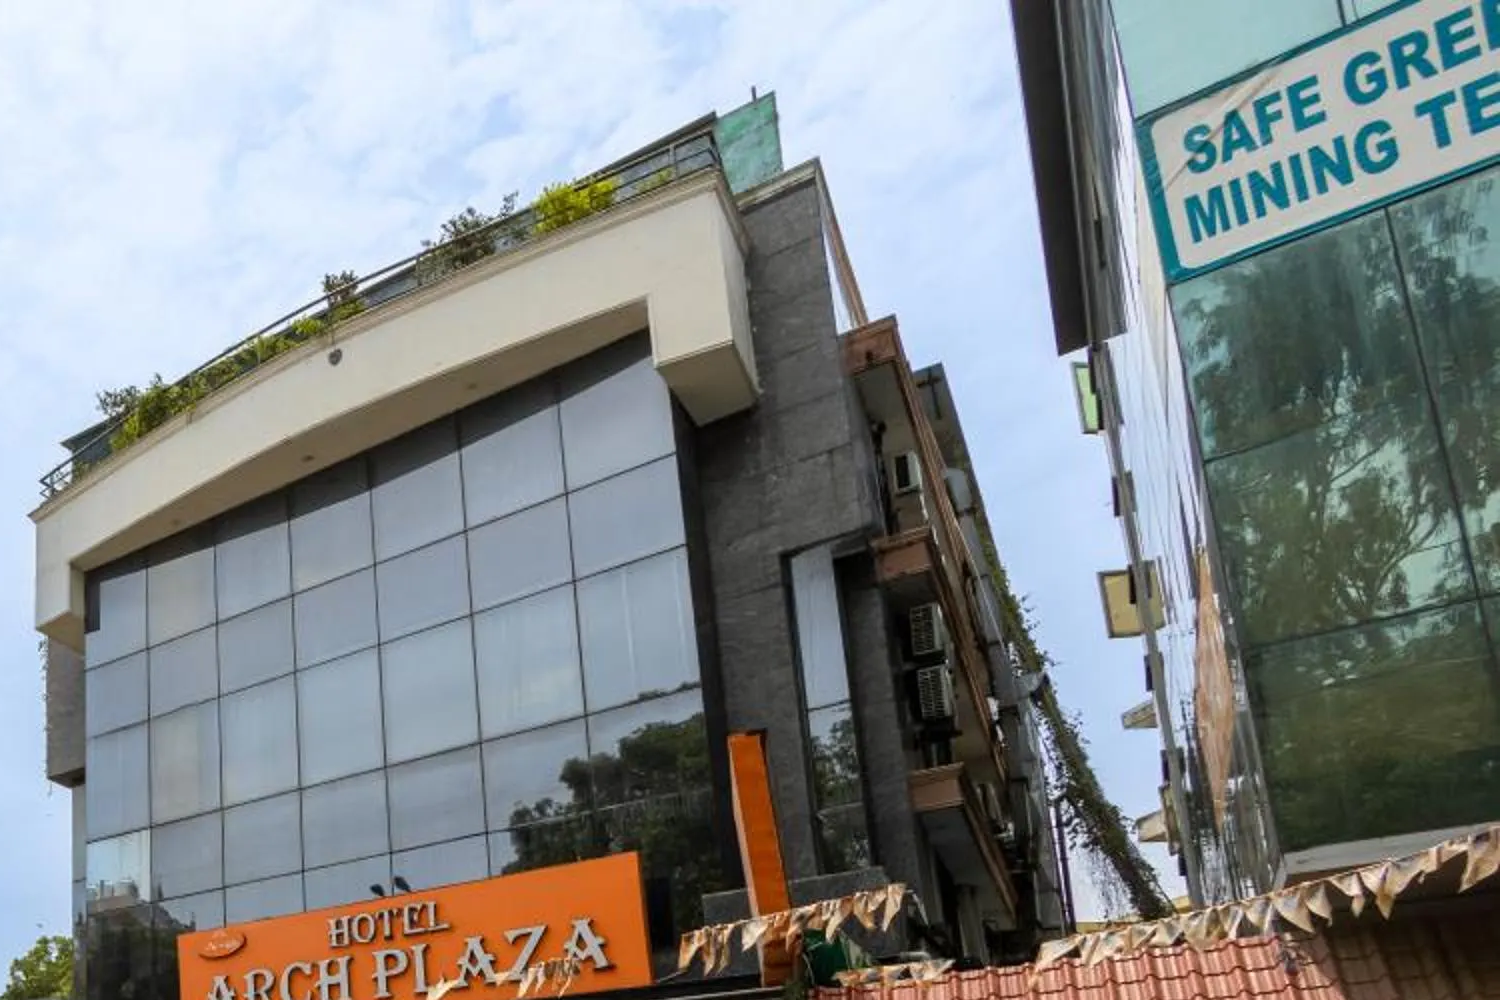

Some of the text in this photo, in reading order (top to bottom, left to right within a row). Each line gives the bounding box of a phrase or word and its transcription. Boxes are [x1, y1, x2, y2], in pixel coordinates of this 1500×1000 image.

[1183, 74, 1327, 174] SAFE
[1183, 119, 1400, 244] MINING
[328, 901, 451, 947] HOTEL
[371, 917, 612, 1000] PLAZA
